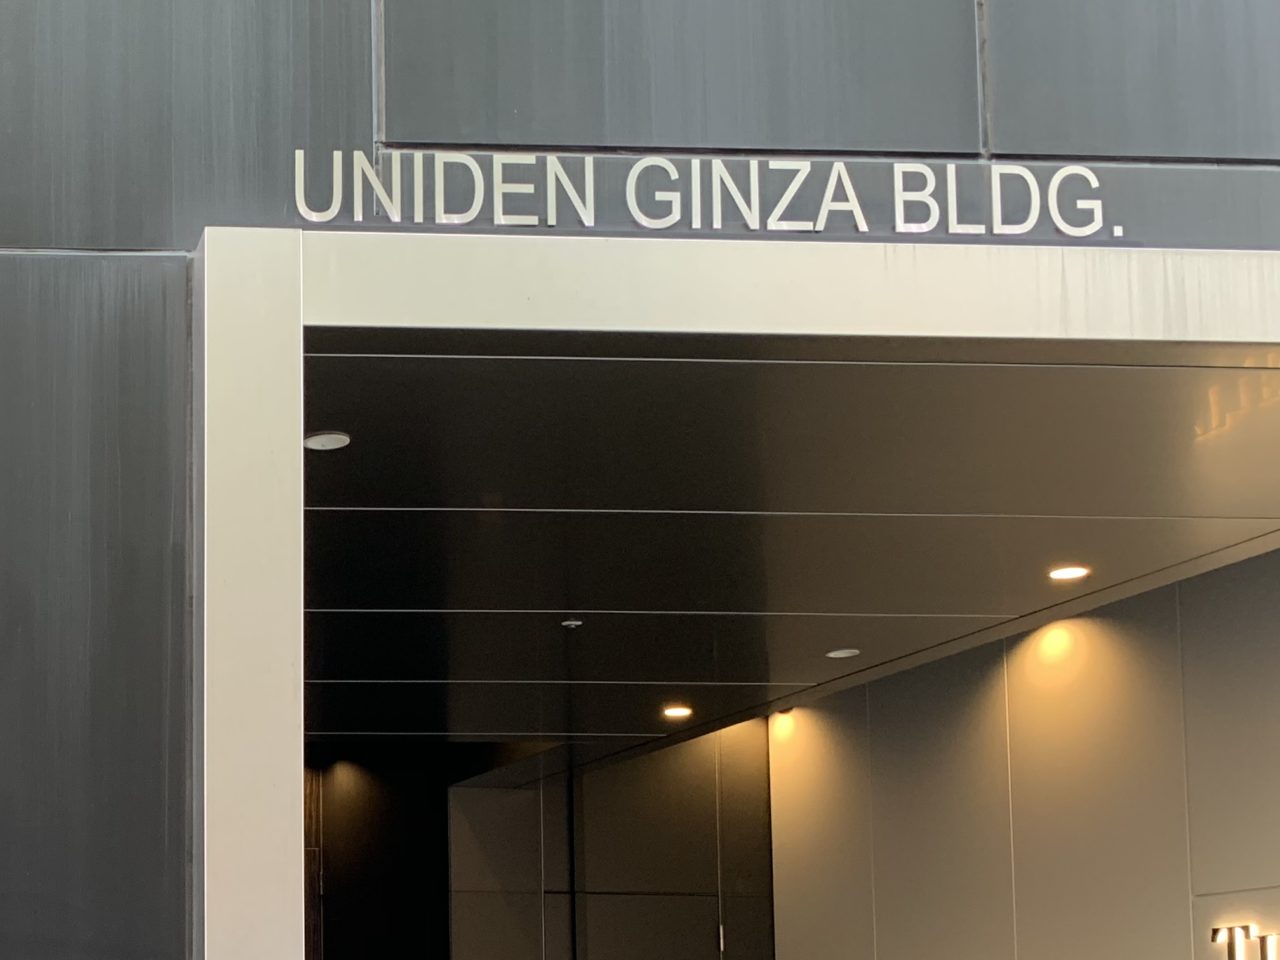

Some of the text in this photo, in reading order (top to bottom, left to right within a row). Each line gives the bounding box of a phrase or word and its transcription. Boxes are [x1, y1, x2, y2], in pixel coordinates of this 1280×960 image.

[294, 149, 1124, 237] UNIDEN GINZA BLDG.
